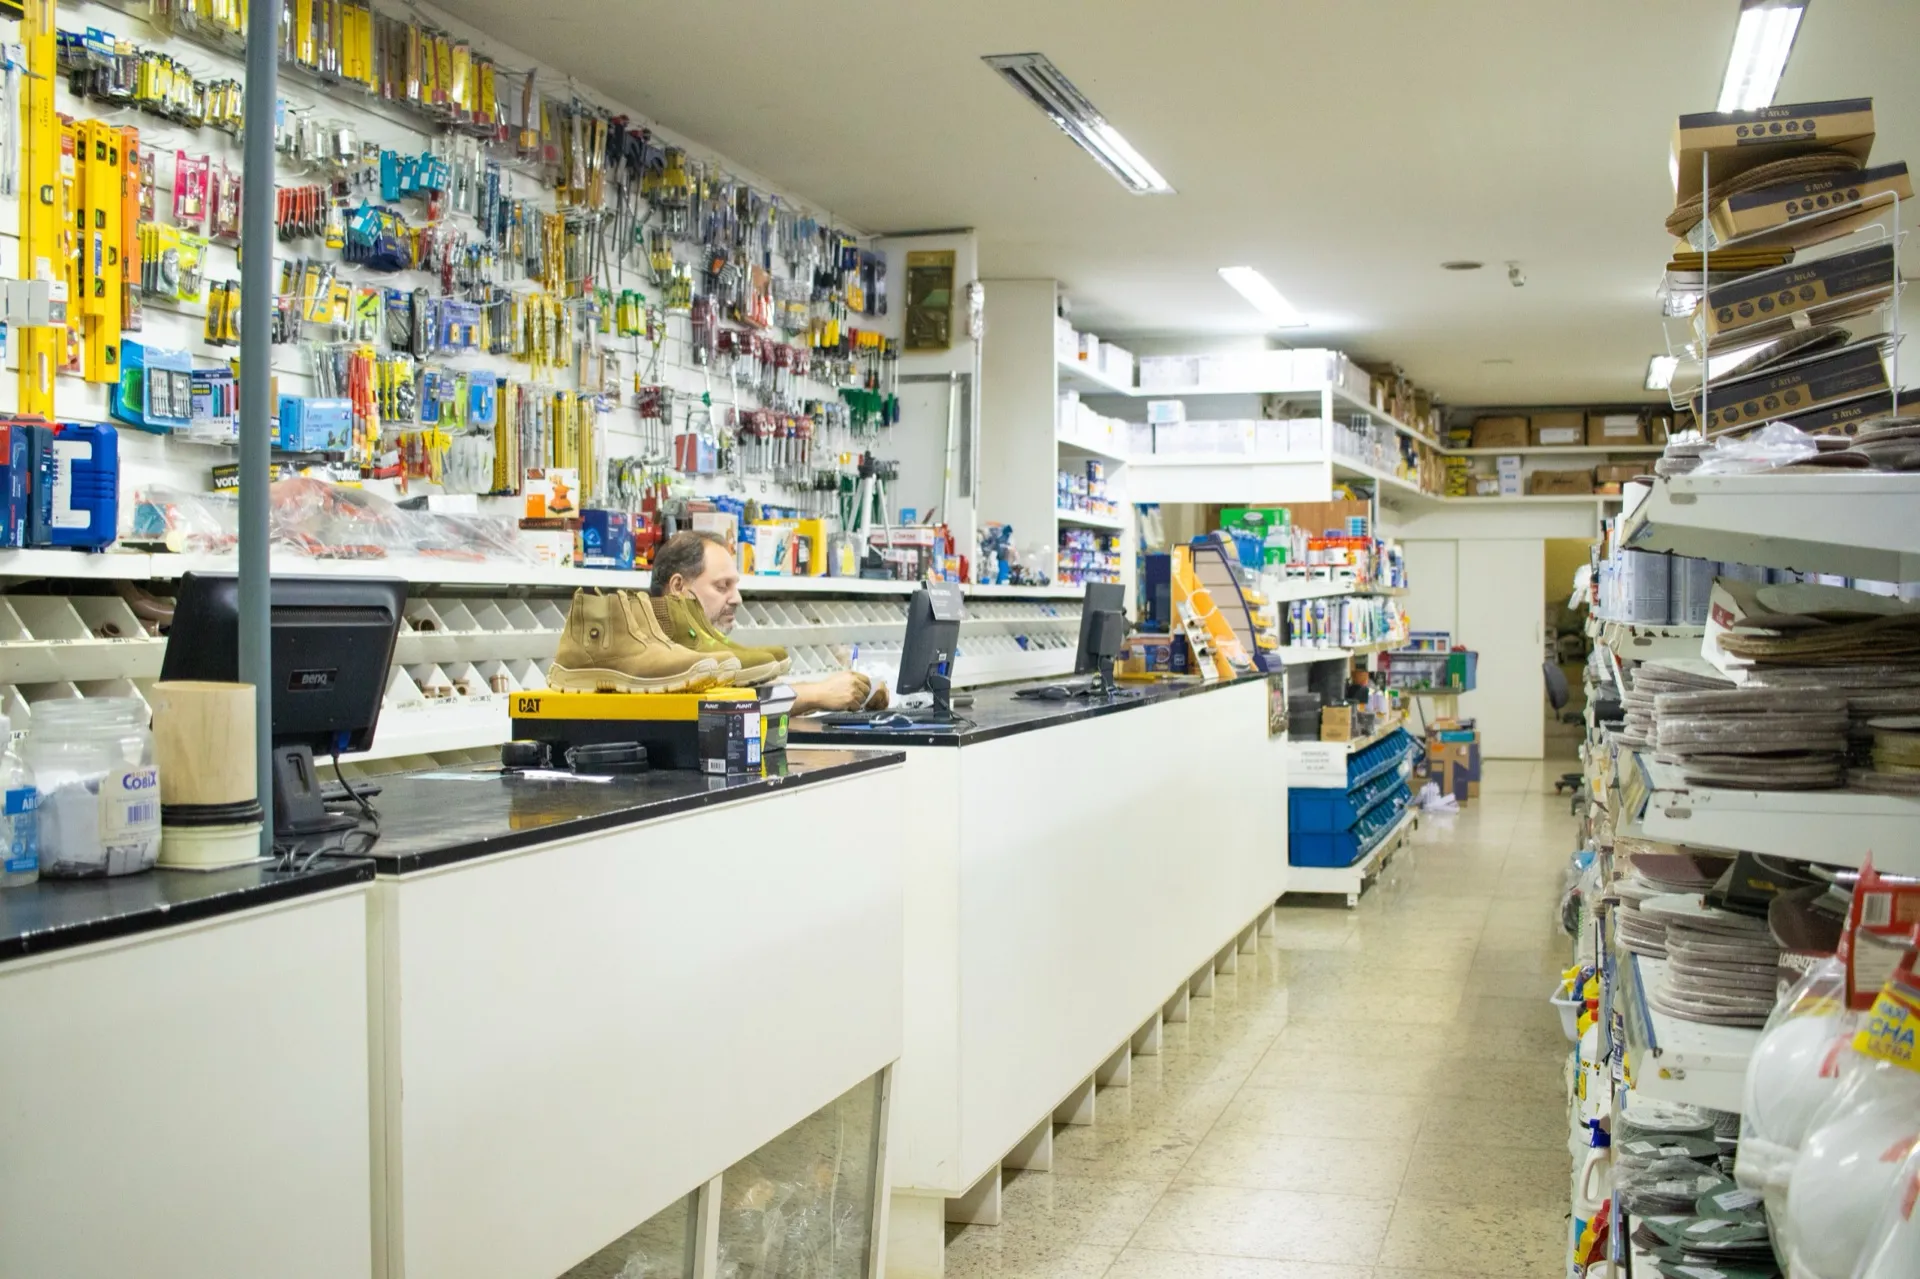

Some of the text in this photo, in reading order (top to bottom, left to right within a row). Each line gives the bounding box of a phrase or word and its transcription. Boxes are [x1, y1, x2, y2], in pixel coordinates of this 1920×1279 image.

[1767, 110, 1790, 118] ATLAS
[1812, 181, 1834, 191] ATLAS
[1794, 270, 1817, 281] ATLAS
[1840, 408, 1862, 418] ATLAS
[518, 697, 541, 713] CAT
